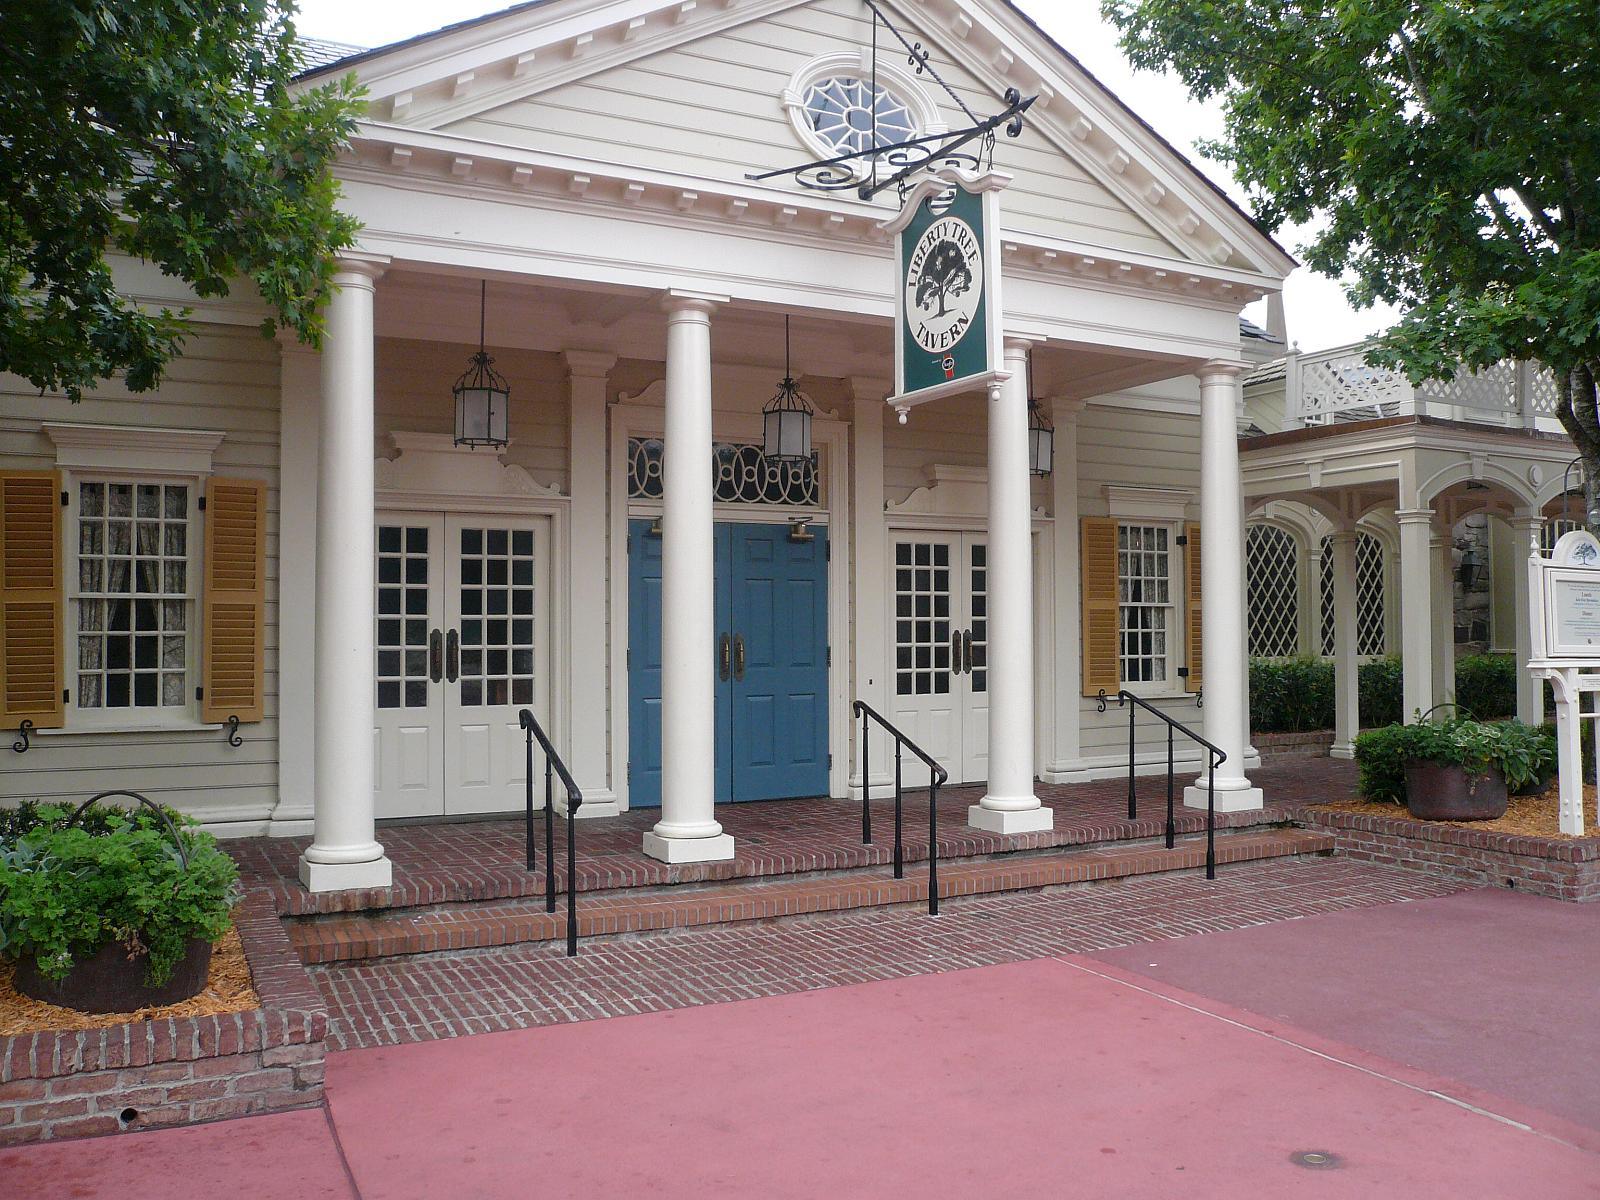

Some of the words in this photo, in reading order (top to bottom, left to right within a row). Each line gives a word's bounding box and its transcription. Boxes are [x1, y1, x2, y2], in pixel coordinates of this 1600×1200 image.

[909, 222, 950, 287] LIBERTY
[952, 222, 978, 266] TREE
[916, 311, 969, 349] TAVERN
